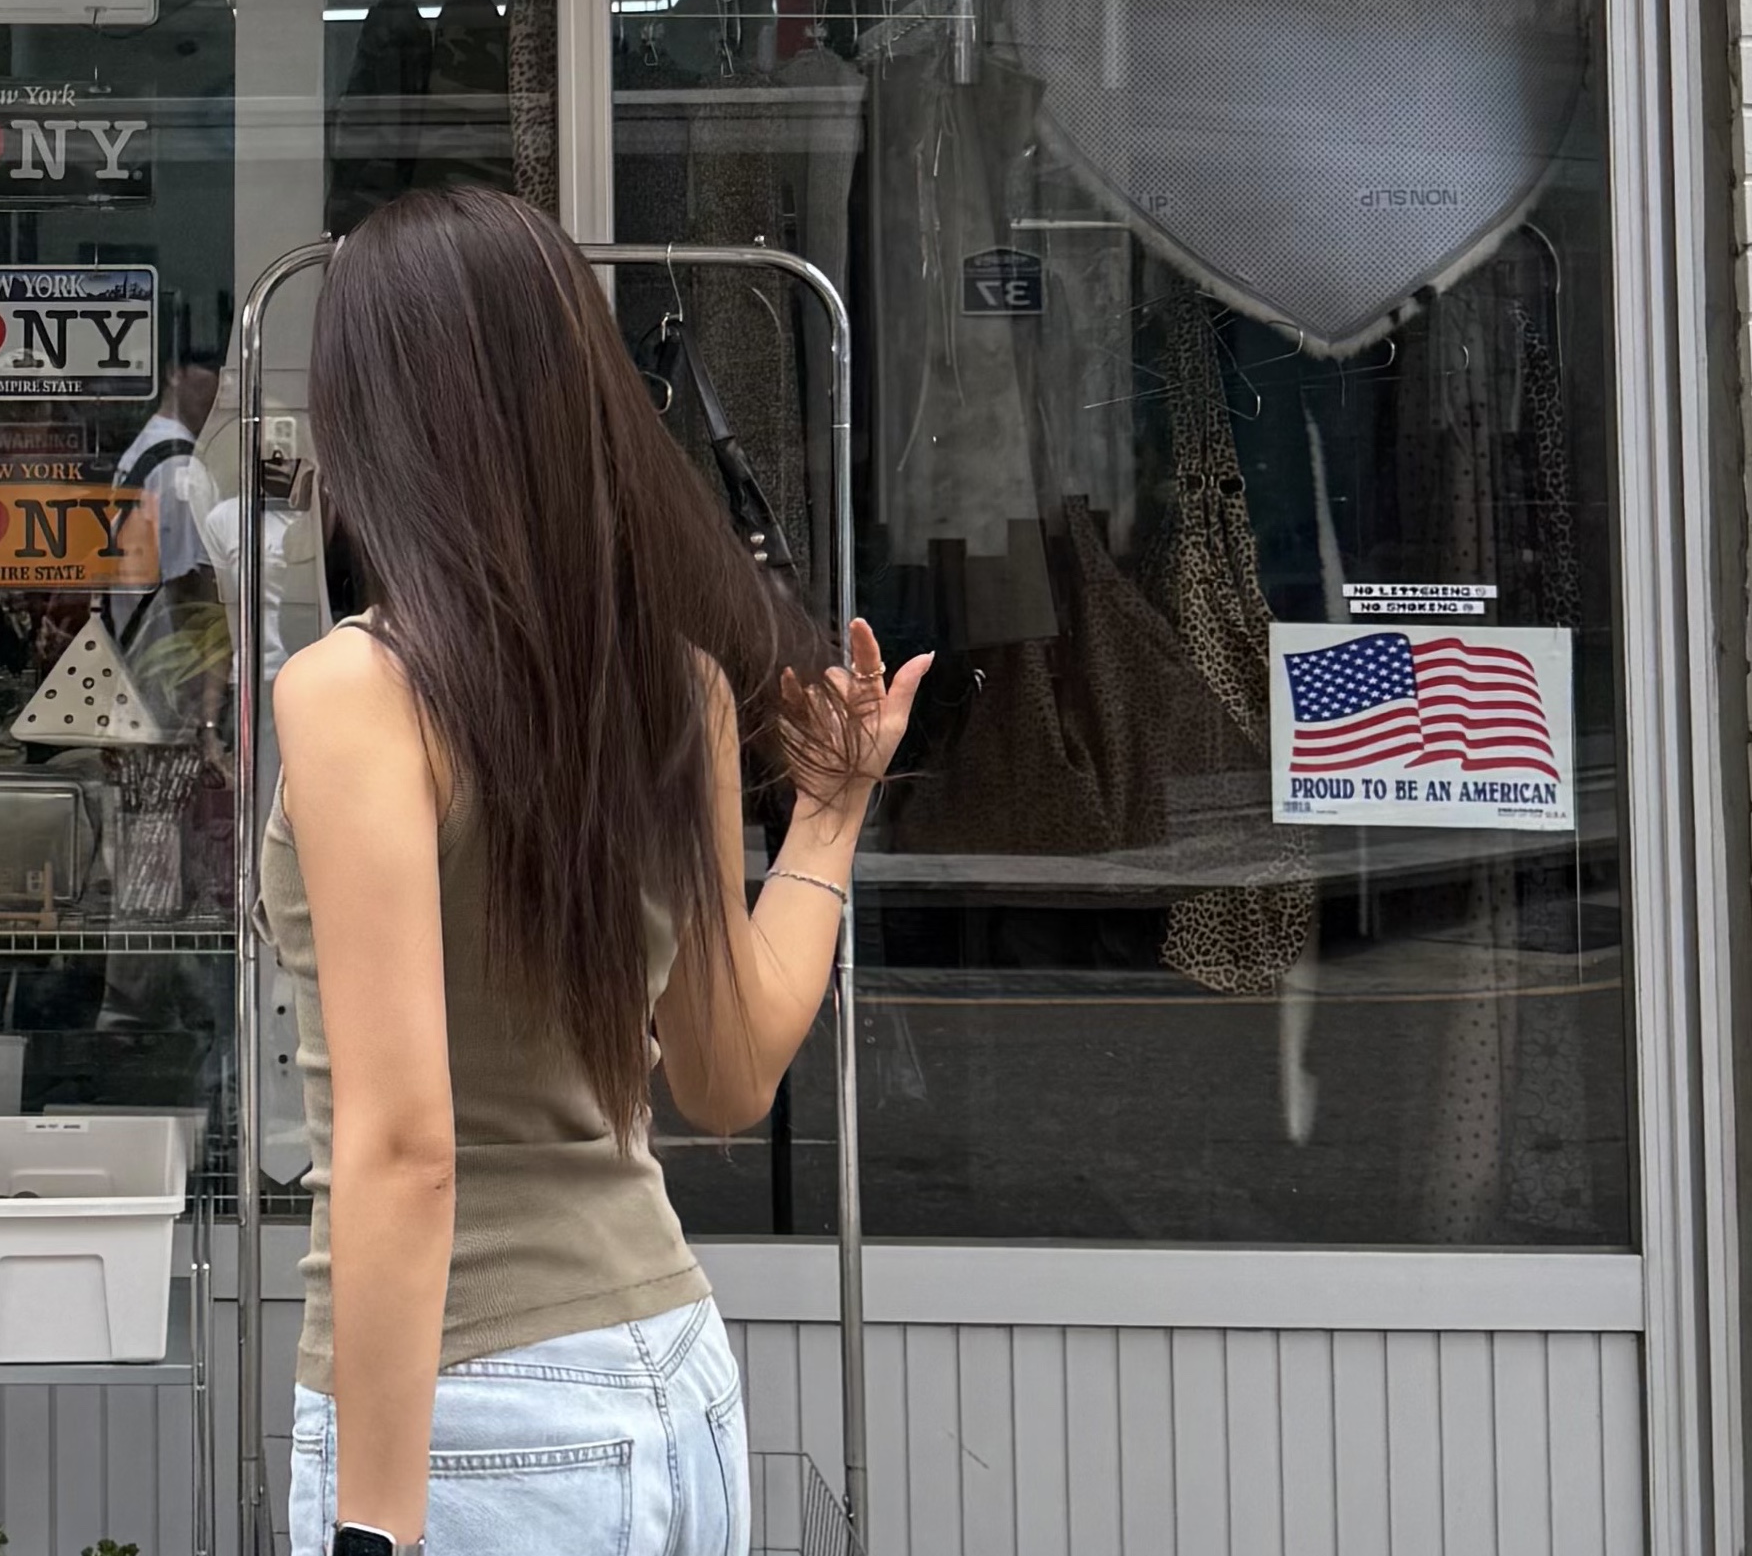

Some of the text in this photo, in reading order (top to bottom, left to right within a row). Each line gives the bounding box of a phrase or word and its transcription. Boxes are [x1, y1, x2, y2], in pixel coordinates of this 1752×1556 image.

[22, 83, 77, 107] York
[10, 119, 148, 180] NY
[19, 274, 88, 298] YORK
[12, 309, 149, 370] NY
[42, 379, 83, 393] STATE
[21, 462, 85, 481] YORK
[14, 498, 141, 559] NY
[34, 564, 86, 581] STATE
[1353, 585, 1374, 595] NO
[1361, 602, 1458, 612] NO SMOKING
[1290, 777, 1557, 804] PROUD TO BE AN AMERICAN
